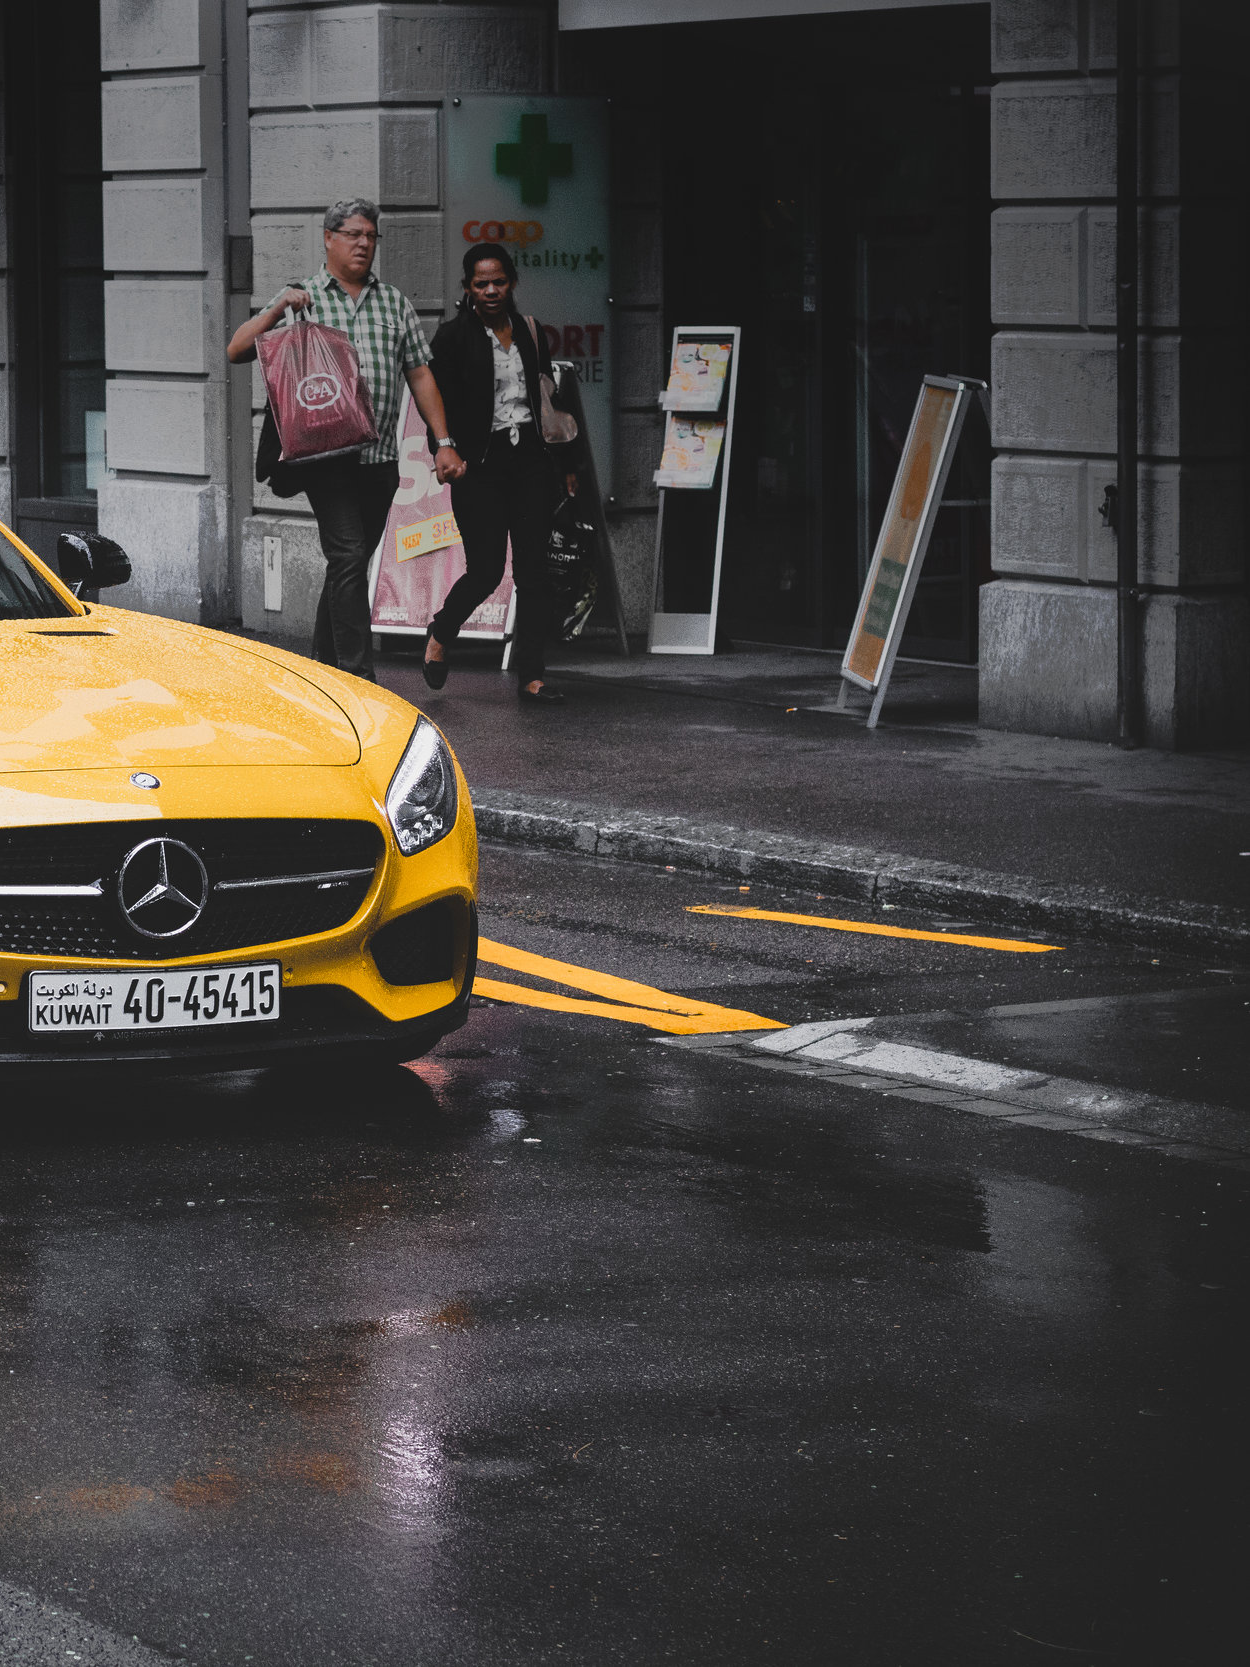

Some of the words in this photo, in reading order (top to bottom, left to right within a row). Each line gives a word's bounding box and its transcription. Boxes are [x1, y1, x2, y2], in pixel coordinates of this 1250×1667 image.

[463, 220, 544, 249] coop
[514, 249, 581, 271] itality
[541, 324, 605, 357] ORT
[304, 381, 335, 401] C&A
[36, 983, 79, 1001] الكويت
[83, 980, 113, 997] دولة
[123, 970, 275, 1024] 40-45415
[36, 1004, 112, 1026] KUWAIT
